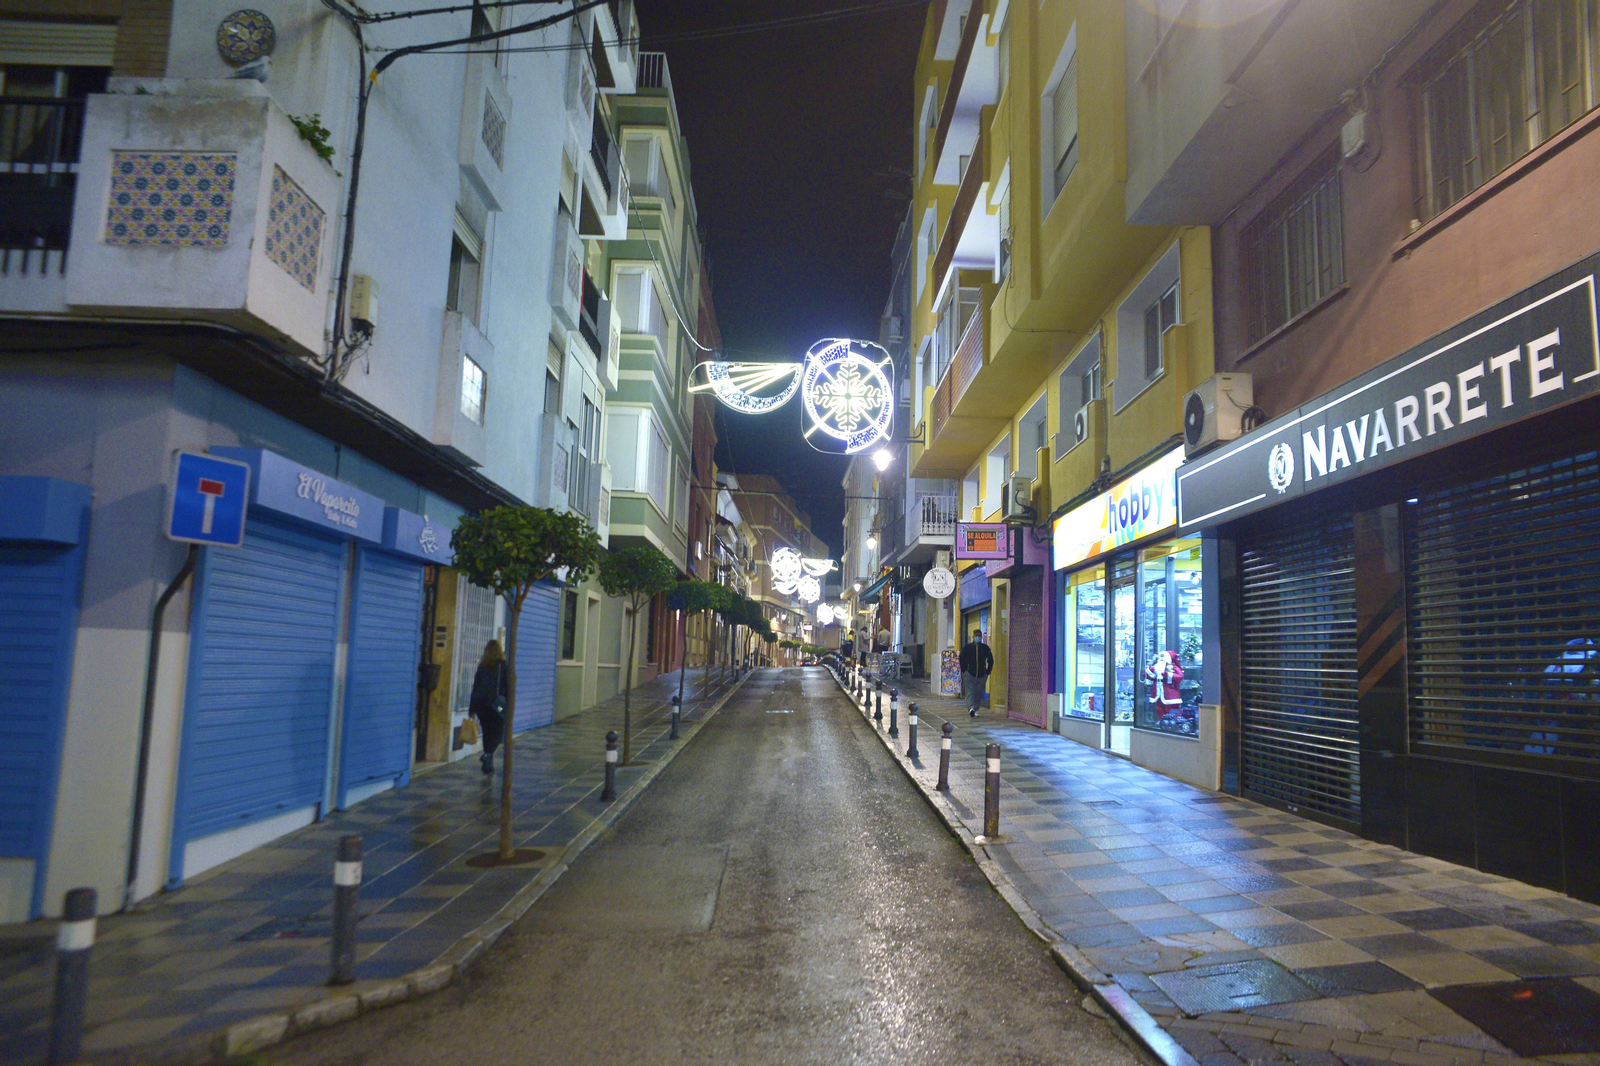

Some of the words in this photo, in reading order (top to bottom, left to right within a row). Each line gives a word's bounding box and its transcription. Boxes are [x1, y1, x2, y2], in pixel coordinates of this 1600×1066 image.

[1302, 327, 1564, 482] NAVARRETE
[297, 472, 312, 499] El
[312, 479, 359, 517] Vaporcito
[1108, 479, 1165, 534] hobby
[968, 532, 974, 540] SE
[975, 532, 996, 540] ALQUILA
